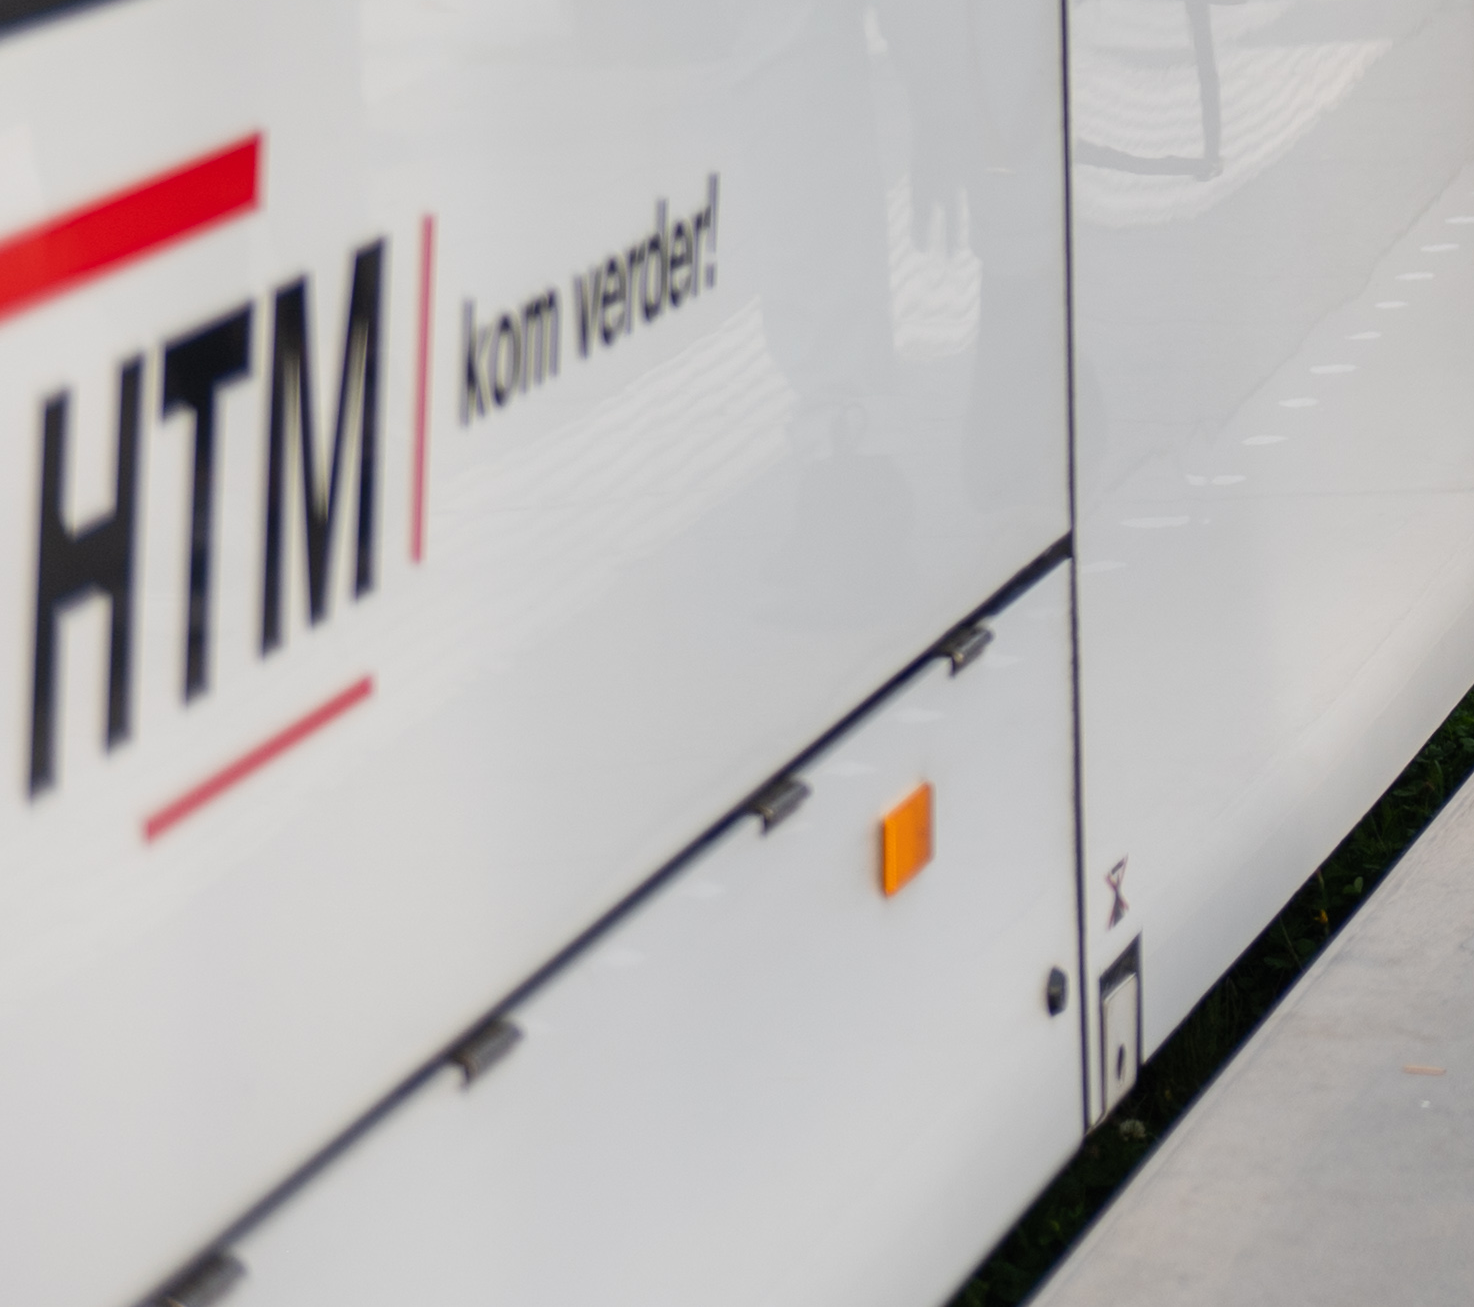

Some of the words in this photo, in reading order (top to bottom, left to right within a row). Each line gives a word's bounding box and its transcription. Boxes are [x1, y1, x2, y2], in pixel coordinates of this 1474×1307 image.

[457, 288, 560, 428] kom
[573, 172, 719, 360] verder!
[27, 235, 389, 806] HTM
